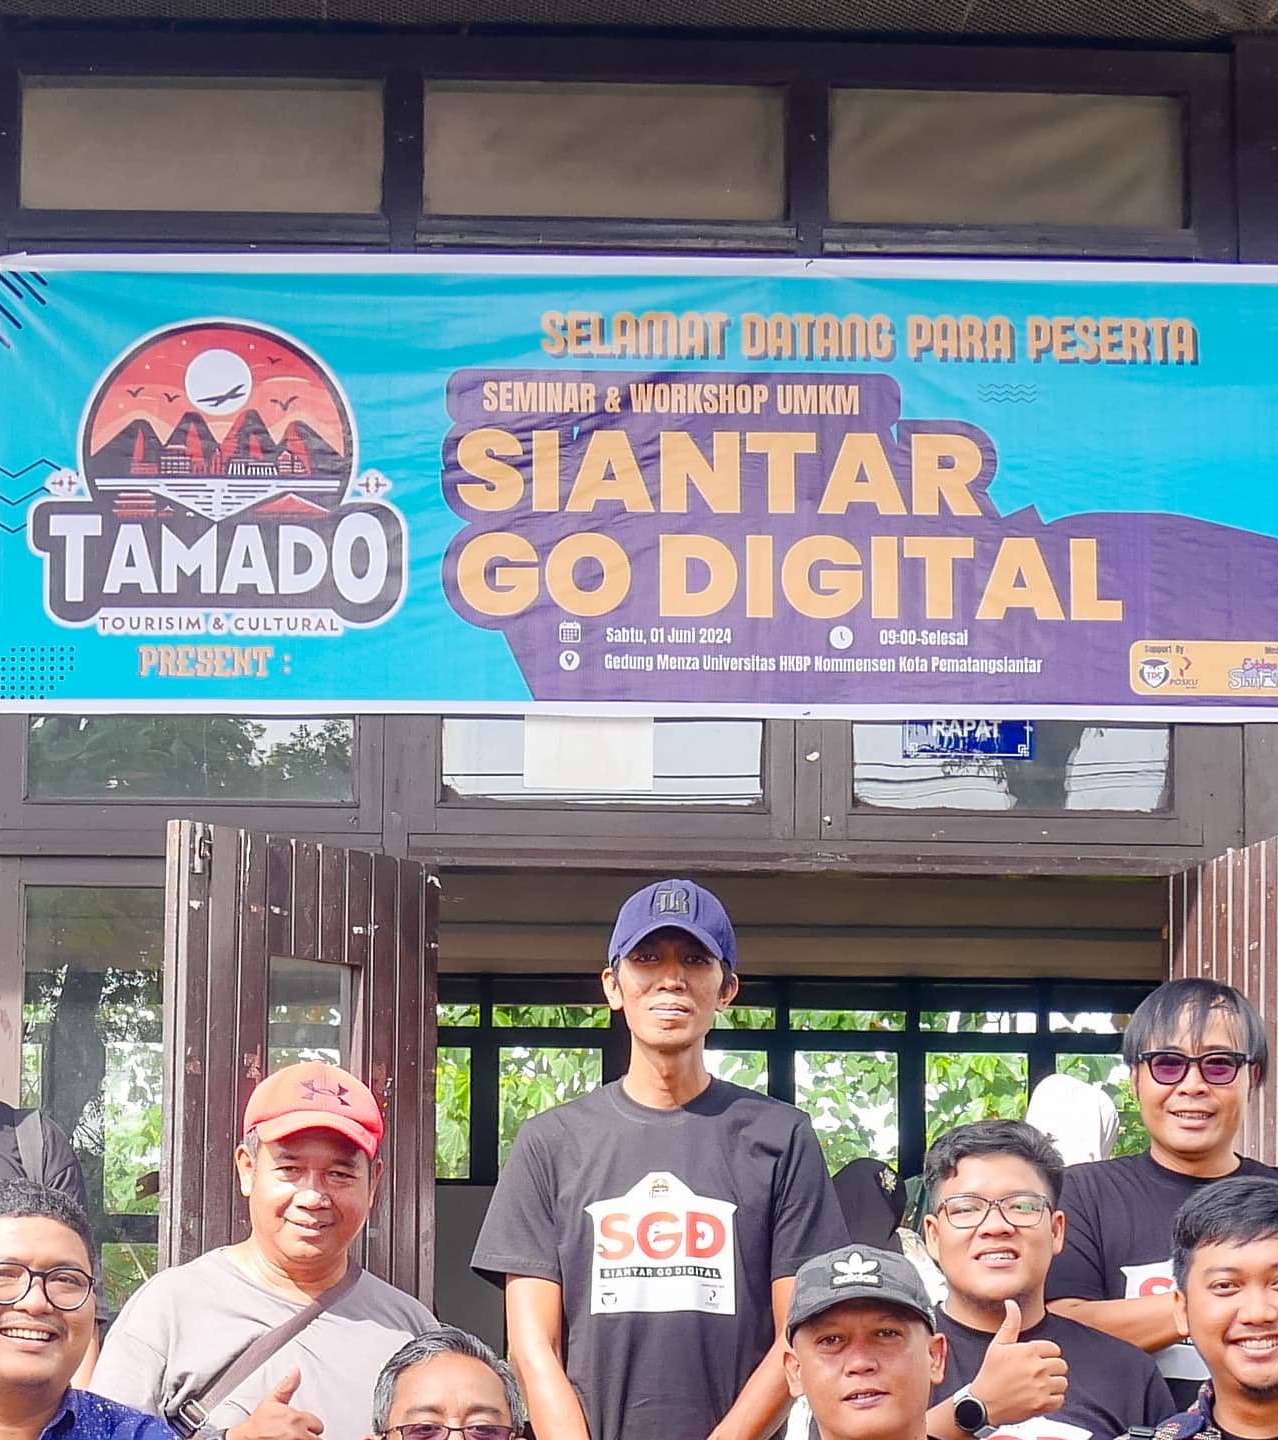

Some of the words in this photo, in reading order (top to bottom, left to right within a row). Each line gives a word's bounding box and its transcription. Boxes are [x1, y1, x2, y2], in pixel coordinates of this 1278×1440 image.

[541, 311, 730, 360] SELAMAT
[742, 313, 895, 362] DATANG
[907, 315, 1015, 363] PARA
[1027, 316, 1198, 365] PESERTA
[482, 381, 596, 413] SEMINAR
[604, 386, 621, 413] &
[630, 383, 769, 414] WORKSHOP
[776, 384, 860, 415] UMKM
[457, 429, 983, 517] SIANTAR
[49, 511, 389, 604] TAMADO
[456, 531, 631, 618] GO
[659, 534, 1123, 621] DIGITAL
[99, 615, 202, 632] TOURISIM
[212, 616, 225, 631] &
[234, 616, 340, 632] CULTURAL
[606, 626, 647, 645] Sabtu,
[650, 627, 665, 643] 01
[667, 627, 696, 644] Juni
[699, 627, 732, 644] 2024
[138, 645, 275, 679] PRESENT
[604, 653, 653, 671] Gedung
[656, 654, 700, 671] Menza
[702, 654, 777, 671] Universitas
[779, 655, 811, 672] HKBP
[814, 656, 896, 673] Nommensen
[899, 656, 928, 672] Kota
[931, 656, 1043, 675] Pematangsiantar
[932, 719, 1002, 738] RAPAT
[596, 1211, 726, 1261] SGD
[602, 1267, 653, 1279] SIANTAR
[675, 1266, 720, 1278] DIGITAL
